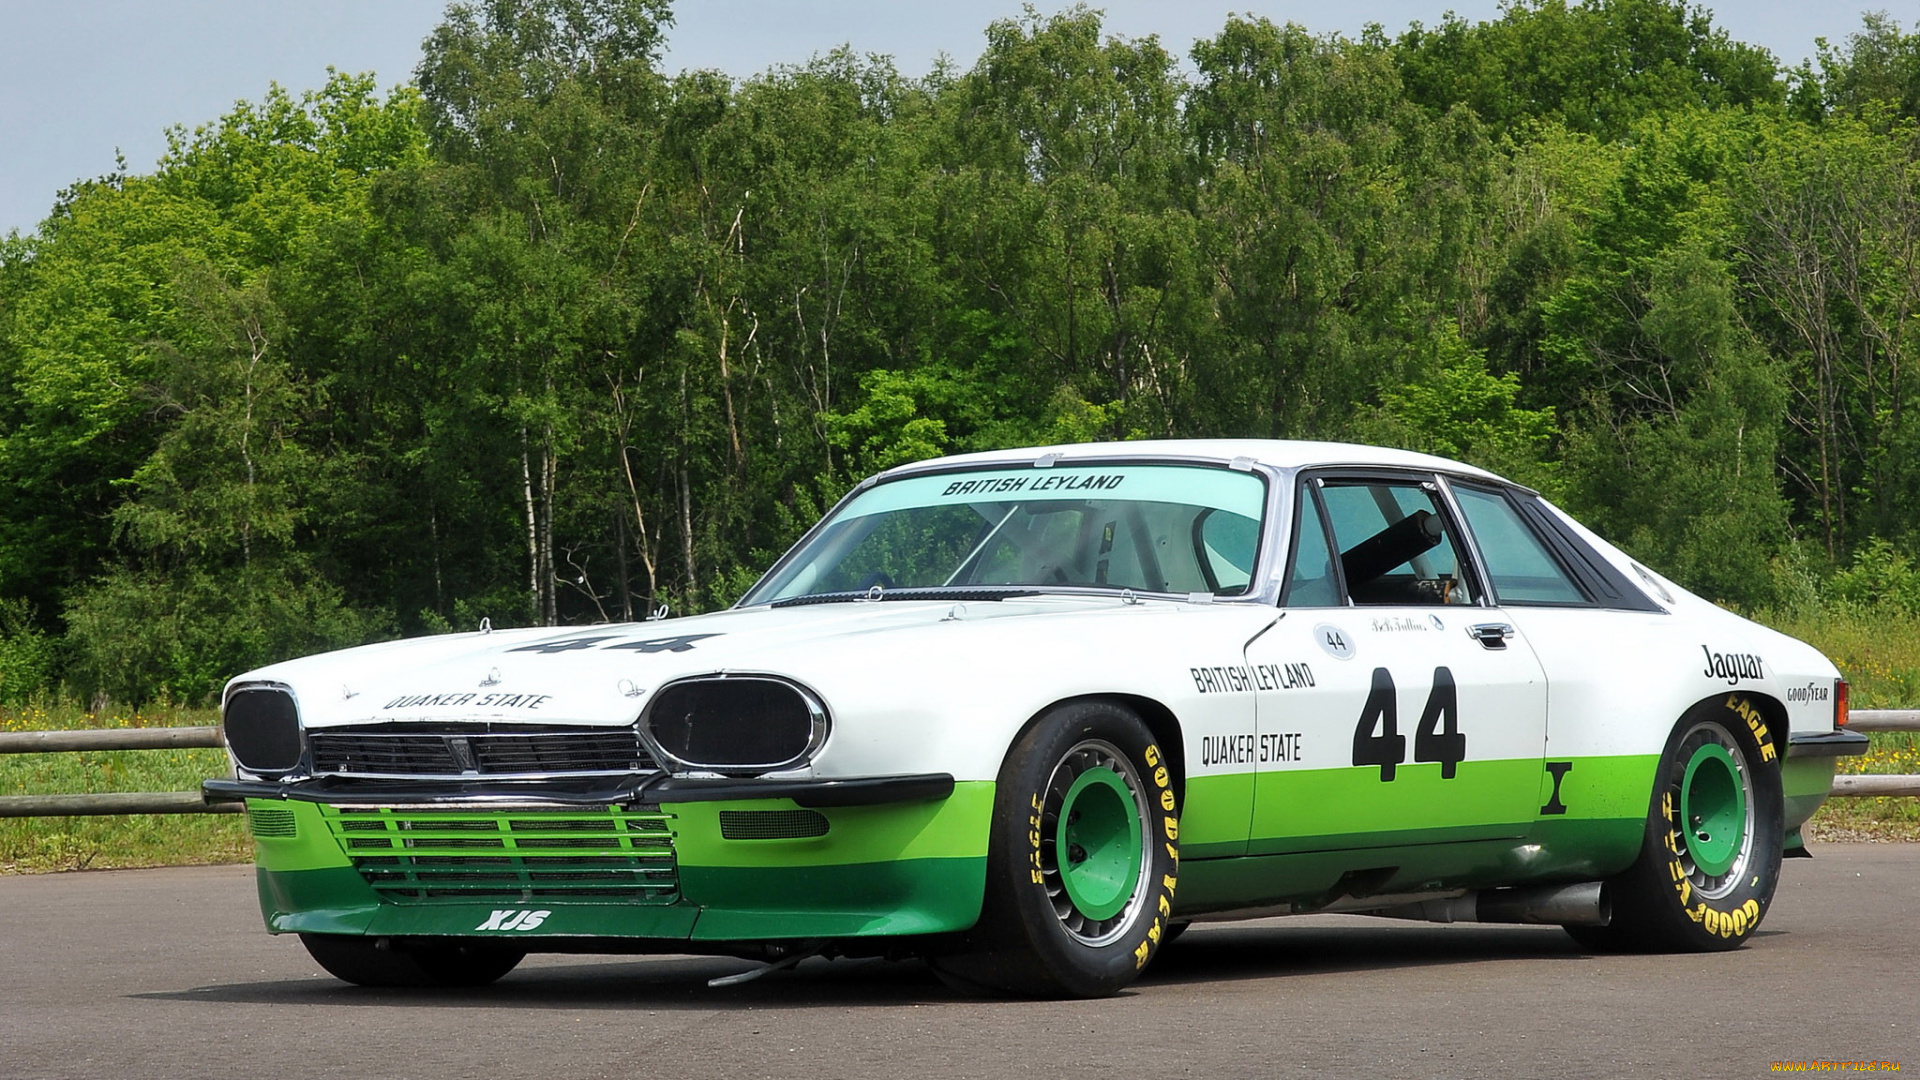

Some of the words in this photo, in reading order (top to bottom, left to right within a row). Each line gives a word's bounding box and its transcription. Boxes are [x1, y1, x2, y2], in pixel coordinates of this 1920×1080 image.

[942, 477, 1030, 496] BRITISH
[1029, 475, 1125, 491] LEYLAND
[505, 632, 725, 654] 44
[1326, 631, 1347, 650] 44
[1190, 666, 1254, 694] BRITISH
[1250, 662, 1316, 691] LEYLAND
[1700, 644, 1764, 686] Jaguar
[383, 693, 478, 711] QUAKER
[476, 693, 553, 710] STATE
[1352, 666, 1466, 782] 44
[1725, 693, 1776, 763] EAGLE
[1202, 735, 1255, 768] QUAKER
[1259, 733, 1302, 763] STATE
[475, 909, 553, 932] XJS
